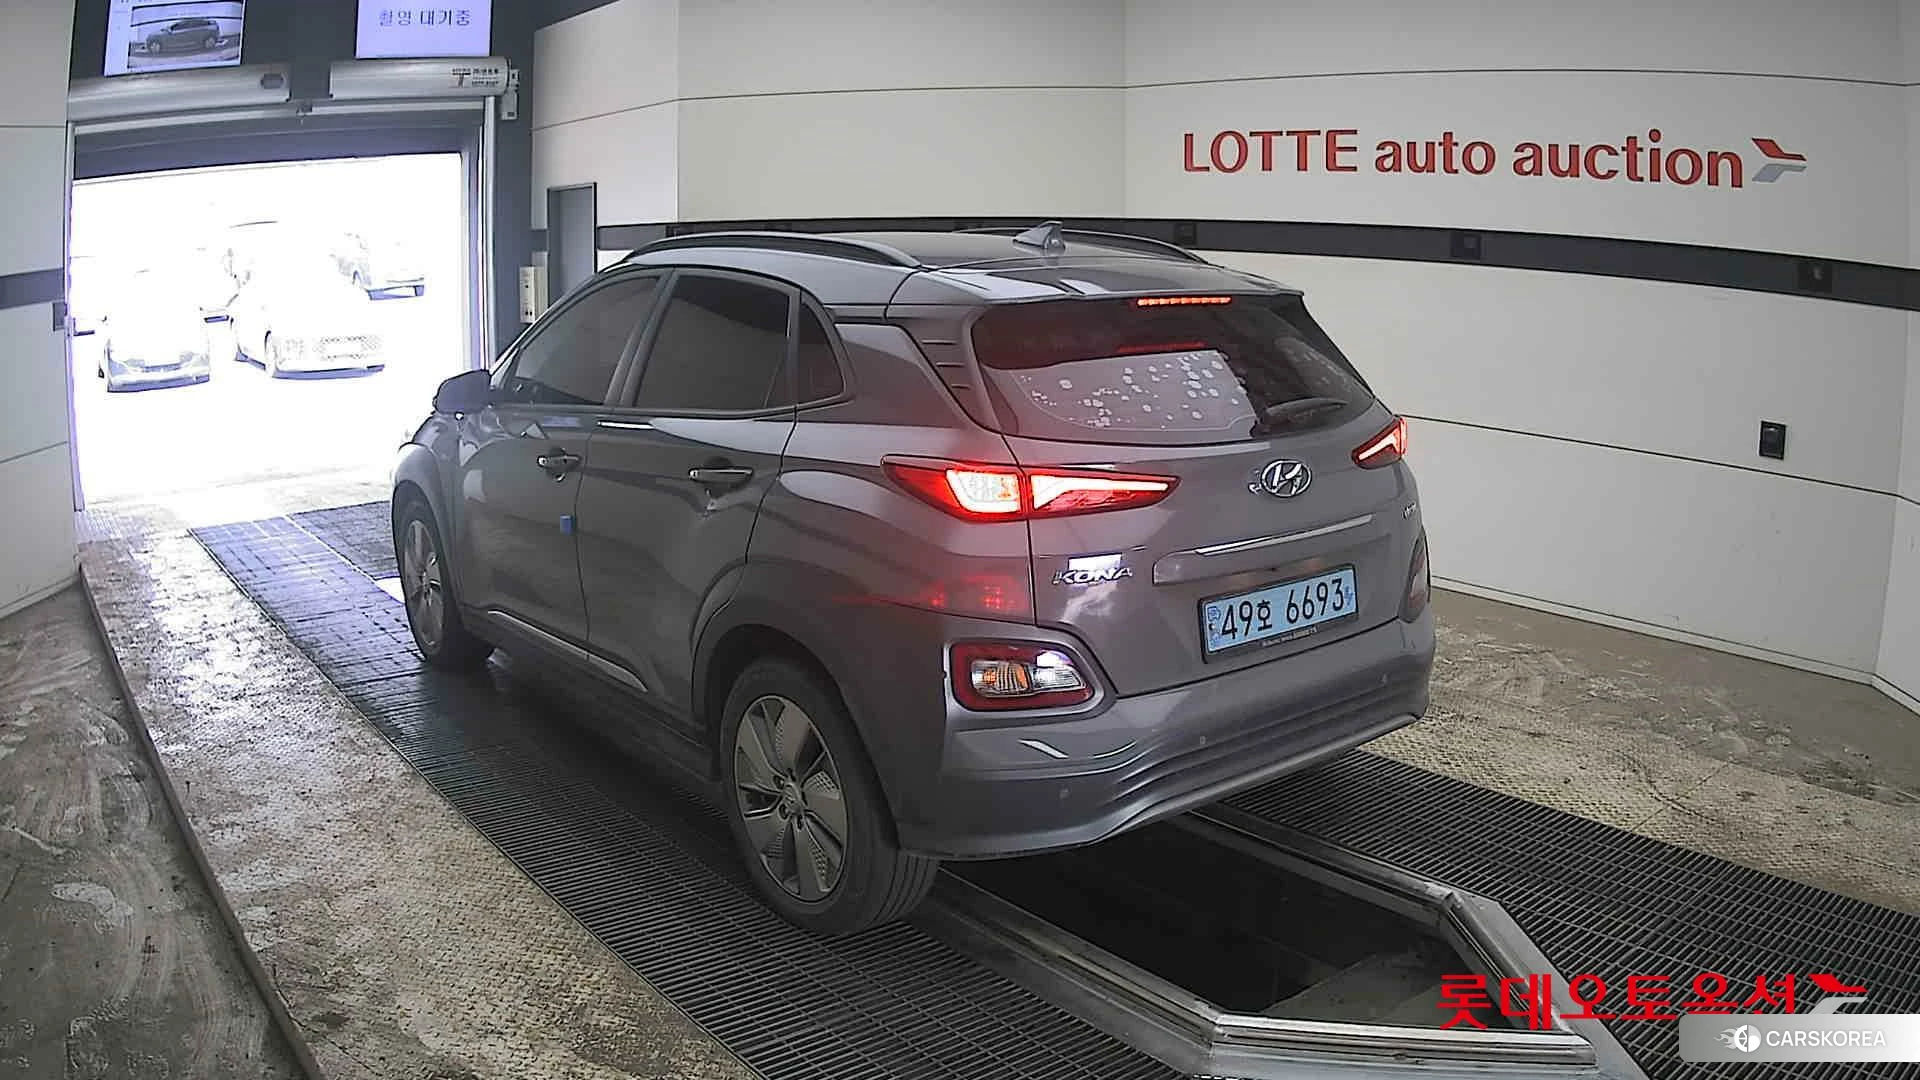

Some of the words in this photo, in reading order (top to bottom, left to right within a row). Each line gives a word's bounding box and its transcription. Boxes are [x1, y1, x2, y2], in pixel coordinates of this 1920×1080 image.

[420, 9, 470, 26] 대기중
[1183, 130, 1358, 173] LOTTE
[1375, 132, 1496, 174] auto
[1512, 129, 1744, 188] auction
[1051, 567, 1133, 585] KONA
[1221, 600, 1273, 640] 49호
[1286, 578, 1344, 625] 6693
